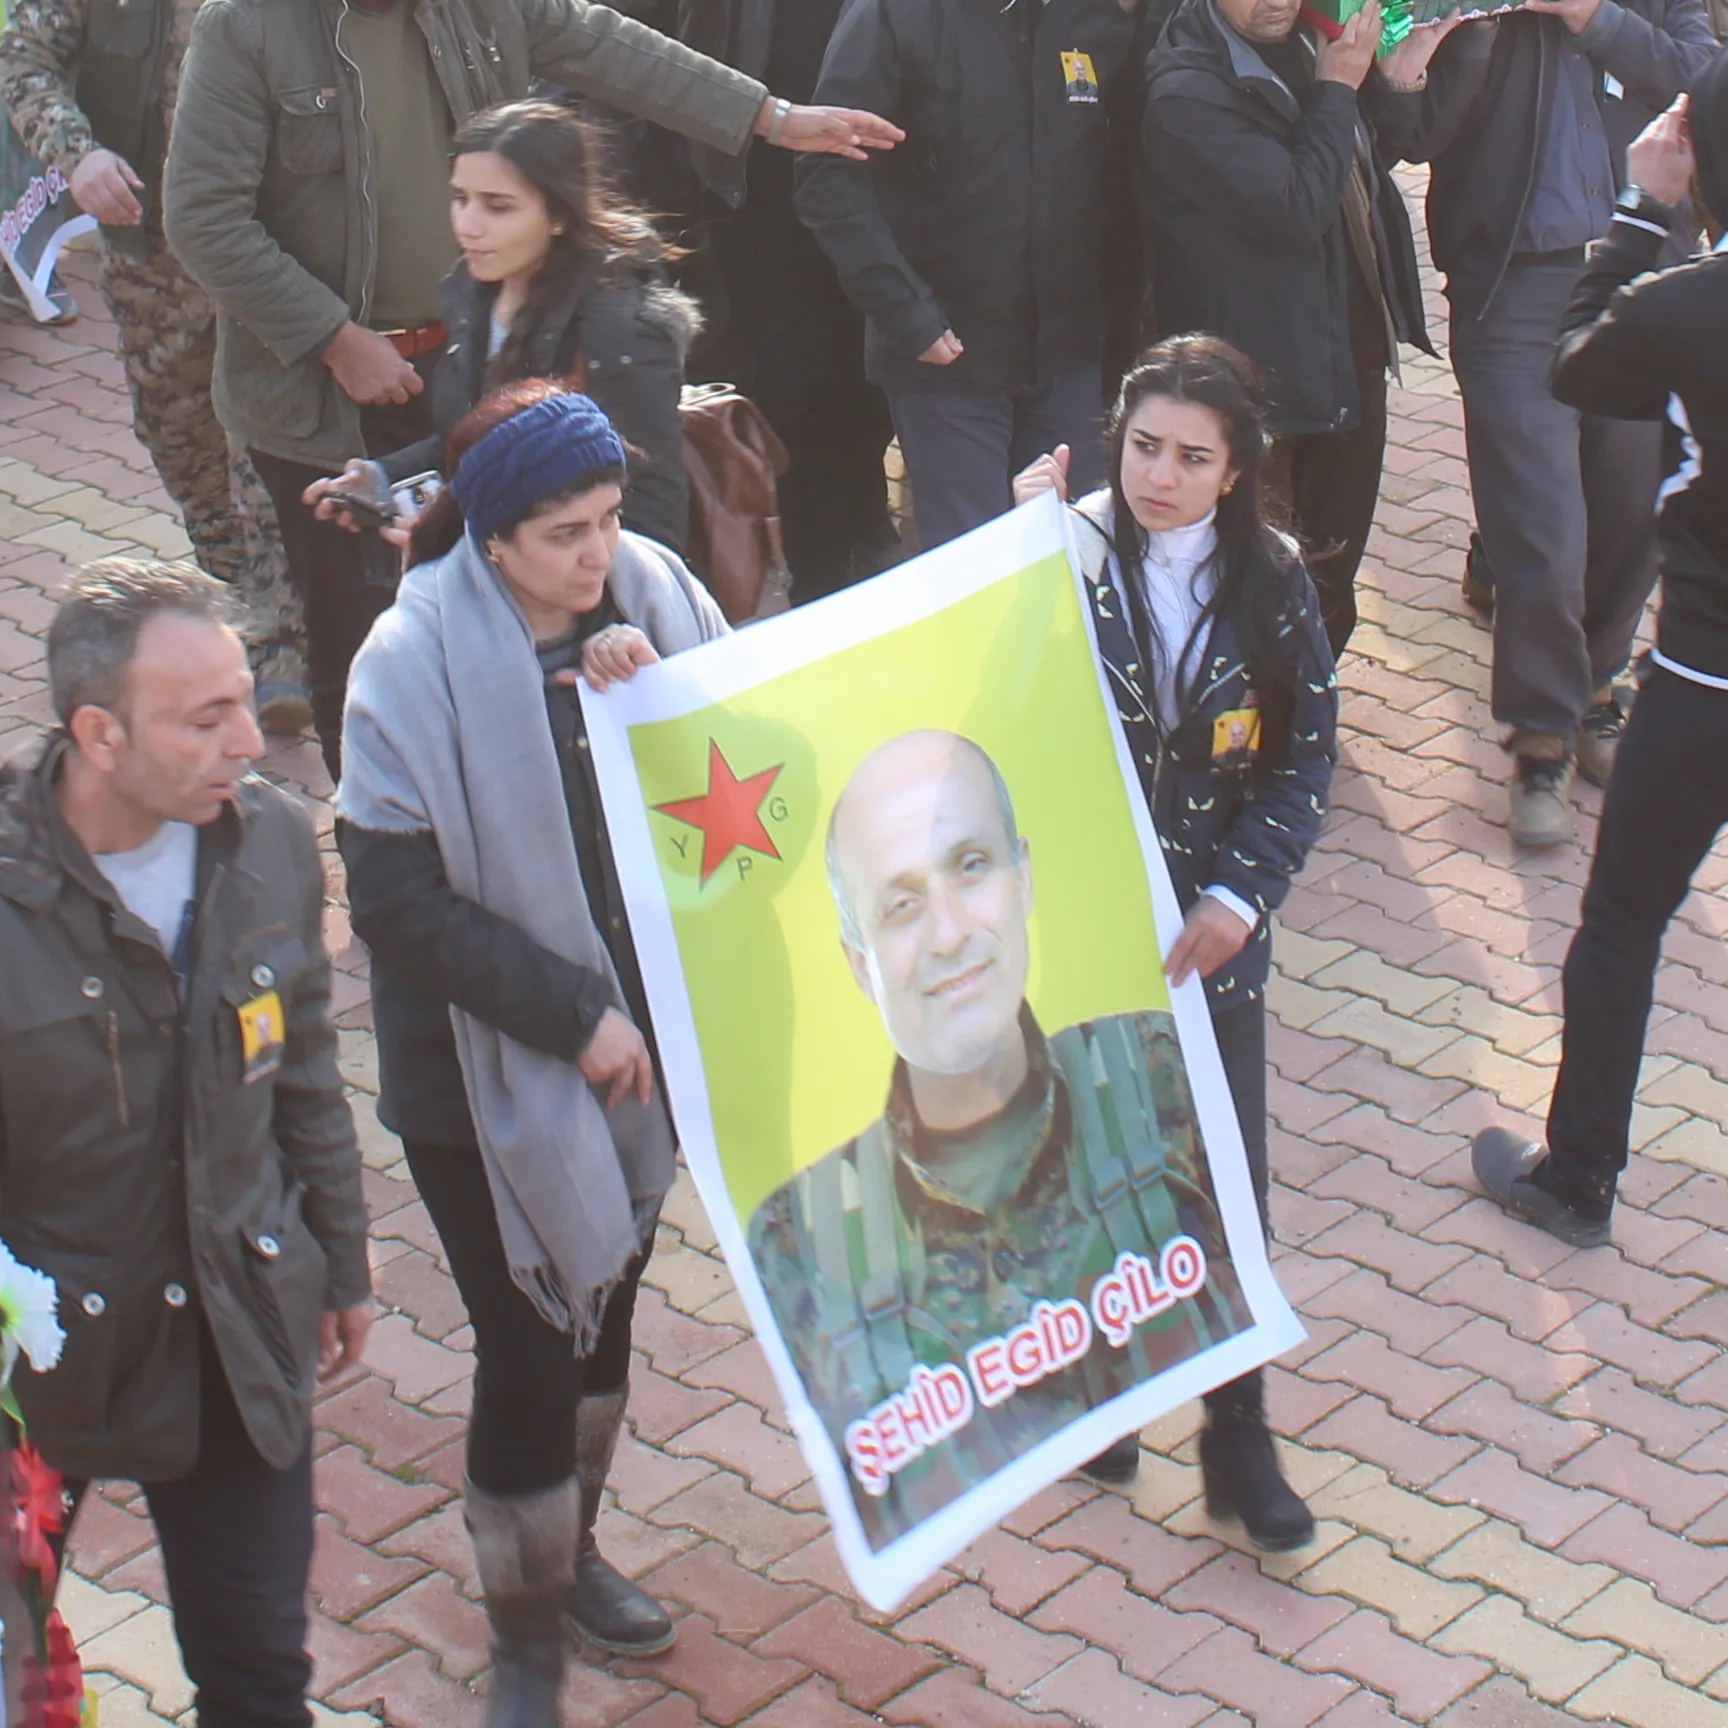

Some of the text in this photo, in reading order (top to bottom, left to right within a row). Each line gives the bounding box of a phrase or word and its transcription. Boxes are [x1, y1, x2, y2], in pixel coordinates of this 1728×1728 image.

[670, 796, 789, 882] Y P G
